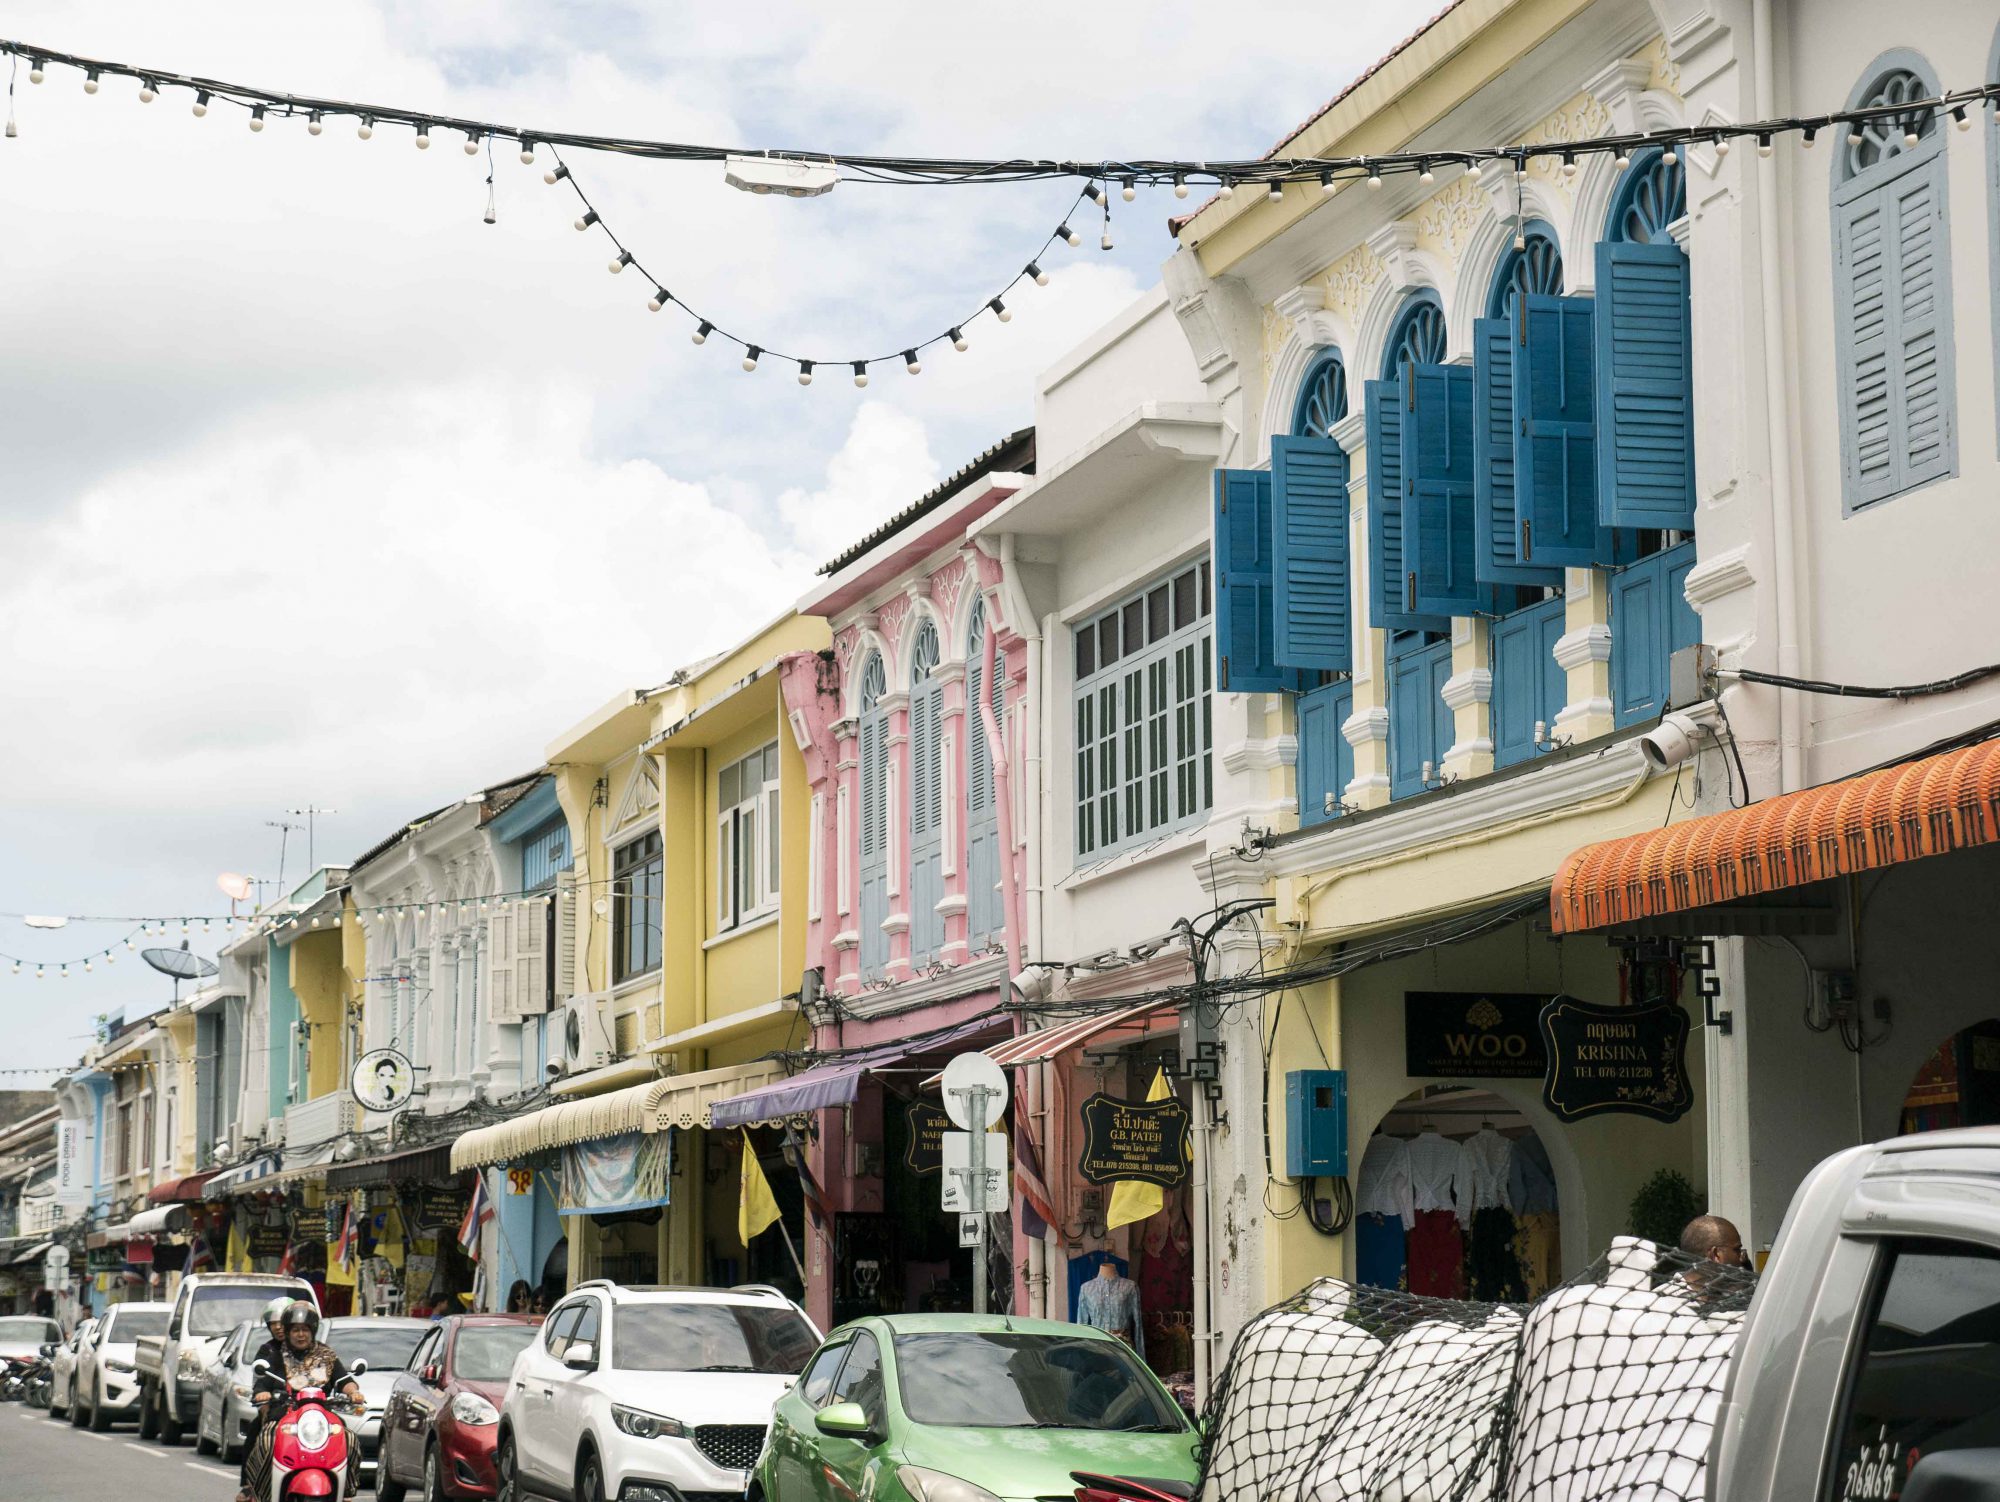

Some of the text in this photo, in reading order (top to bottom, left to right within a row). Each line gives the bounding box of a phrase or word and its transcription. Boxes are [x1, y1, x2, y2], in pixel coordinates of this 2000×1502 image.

[1444, 1033, 1527, 1057] WOO
[1577, 1045, 1648, 1061] KRISHNA
[1131, 1131, 1162, 1142] PATEH
